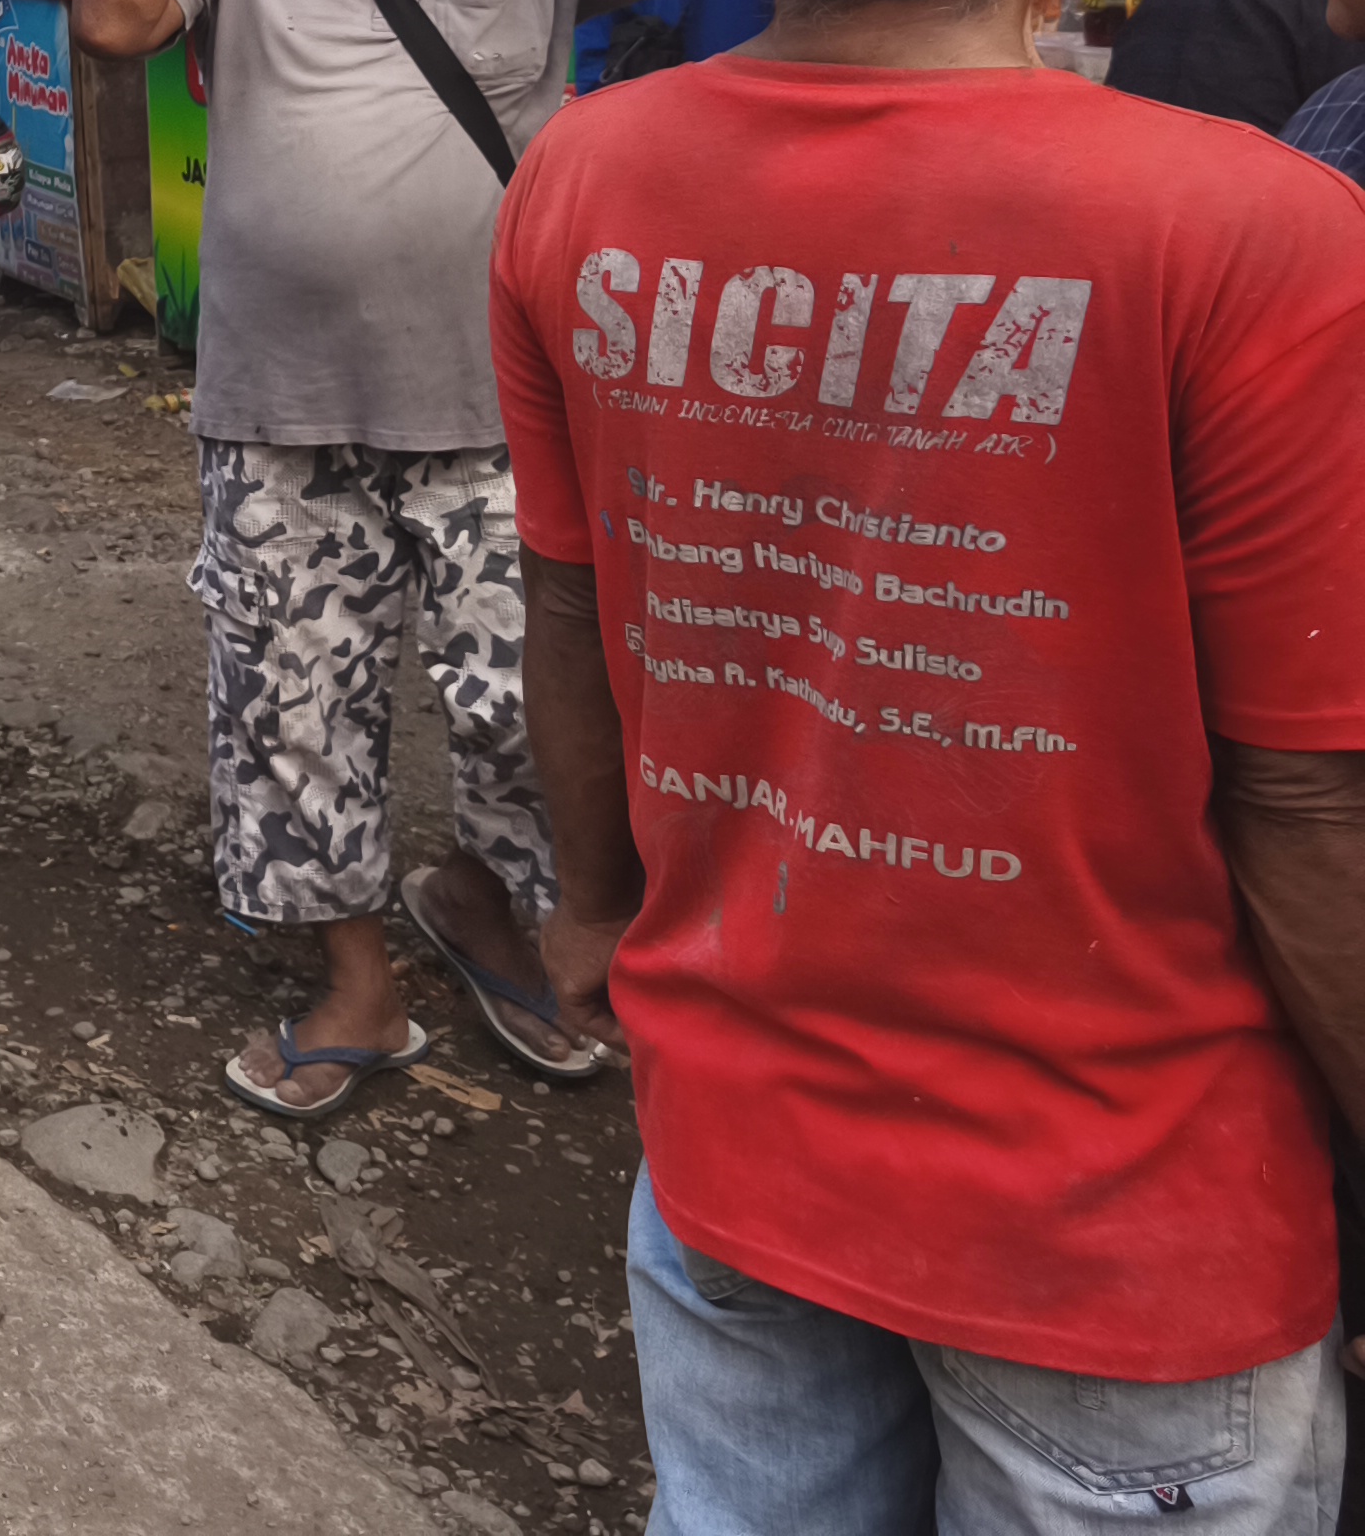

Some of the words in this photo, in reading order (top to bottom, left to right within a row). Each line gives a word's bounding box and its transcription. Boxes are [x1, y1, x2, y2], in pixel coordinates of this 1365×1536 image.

[572, 247, 1093, 426] SICITA
[887, 425, 966, 451] TANAH
[693, 478, 803, 526] Henry
[815, 495, 1007, 553] Christianto
[874, 571, 1070, 621] Bachrudin
[646, 590, 802, 640] Adisatrya
[854, 635, 983, 683] Sulisto
